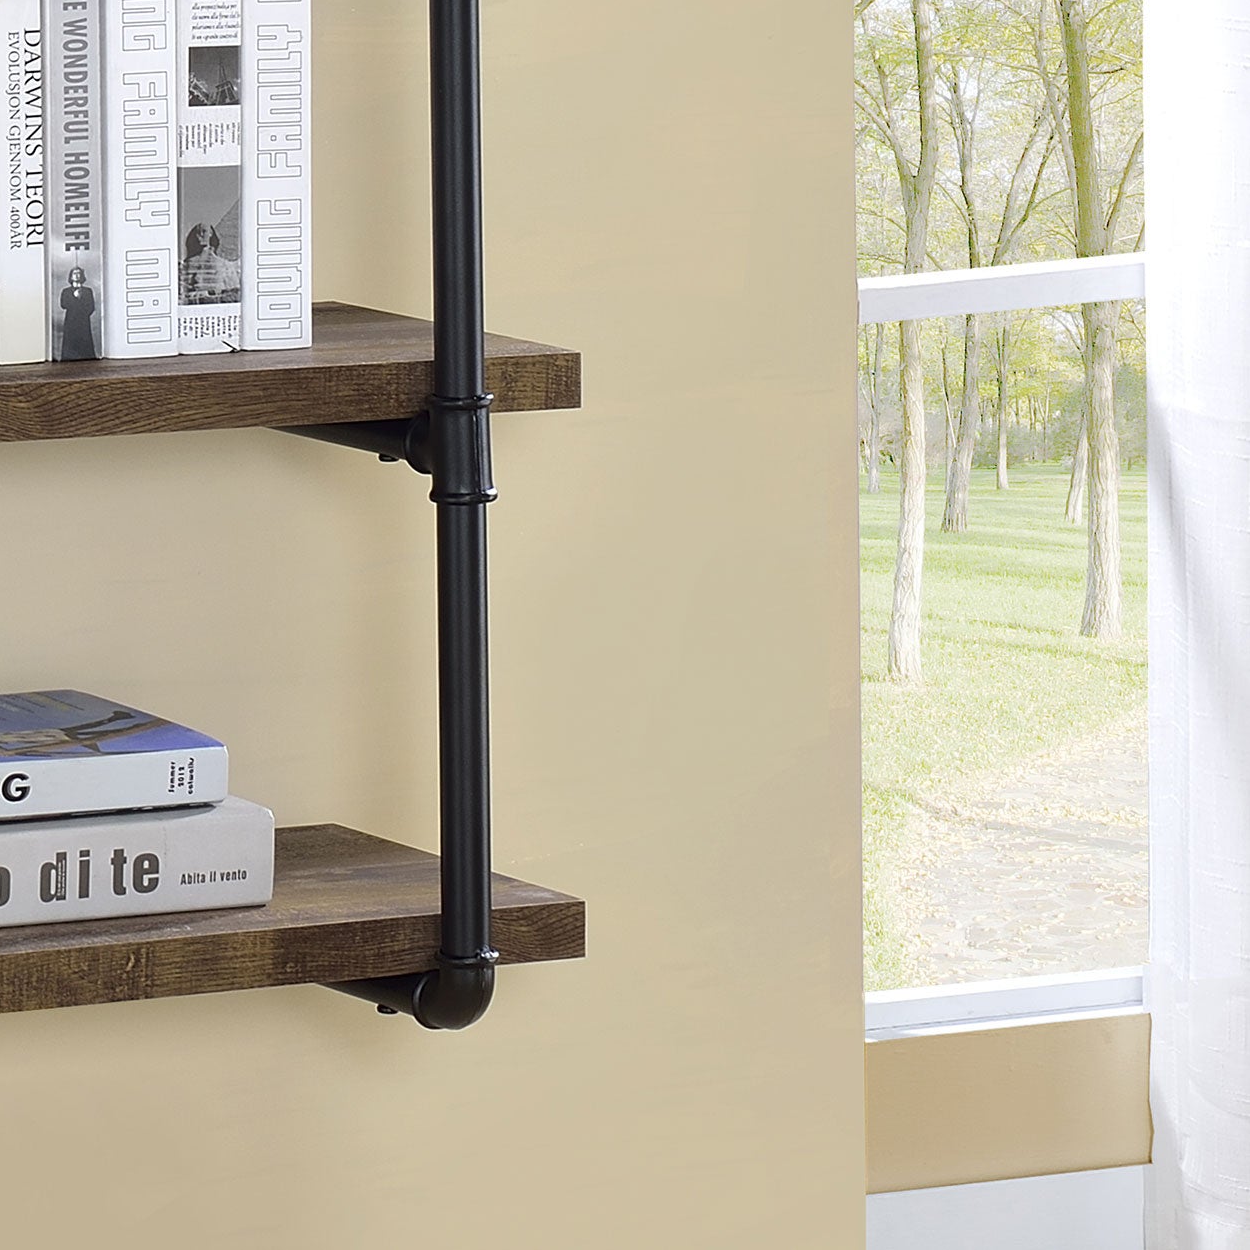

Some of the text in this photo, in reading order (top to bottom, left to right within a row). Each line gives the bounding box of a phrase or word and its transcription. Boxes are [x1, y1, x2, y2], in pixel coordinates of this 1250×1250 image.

[5, 31, 24, 250] EVOLUSJON GJENNOM 400ÅR
[23, 27, 45, 248] DARWINS TEORI
[62, 17, 89, 145] WONDERFUL
[257, 24, 304, 179] FAMILY
[63, 151, 90, 252] HOMELIFE
[122, 71, 171, 228] FAMILY
[125, 248, 173, 345] MAN
[257, 198, 303, 341] LOVING
[167, 761, 175, 793] Summer
[40, 849, 91, 903] di
[111, 848, 160, 897] te
[180, 868, 248, 886] Abita il vento
